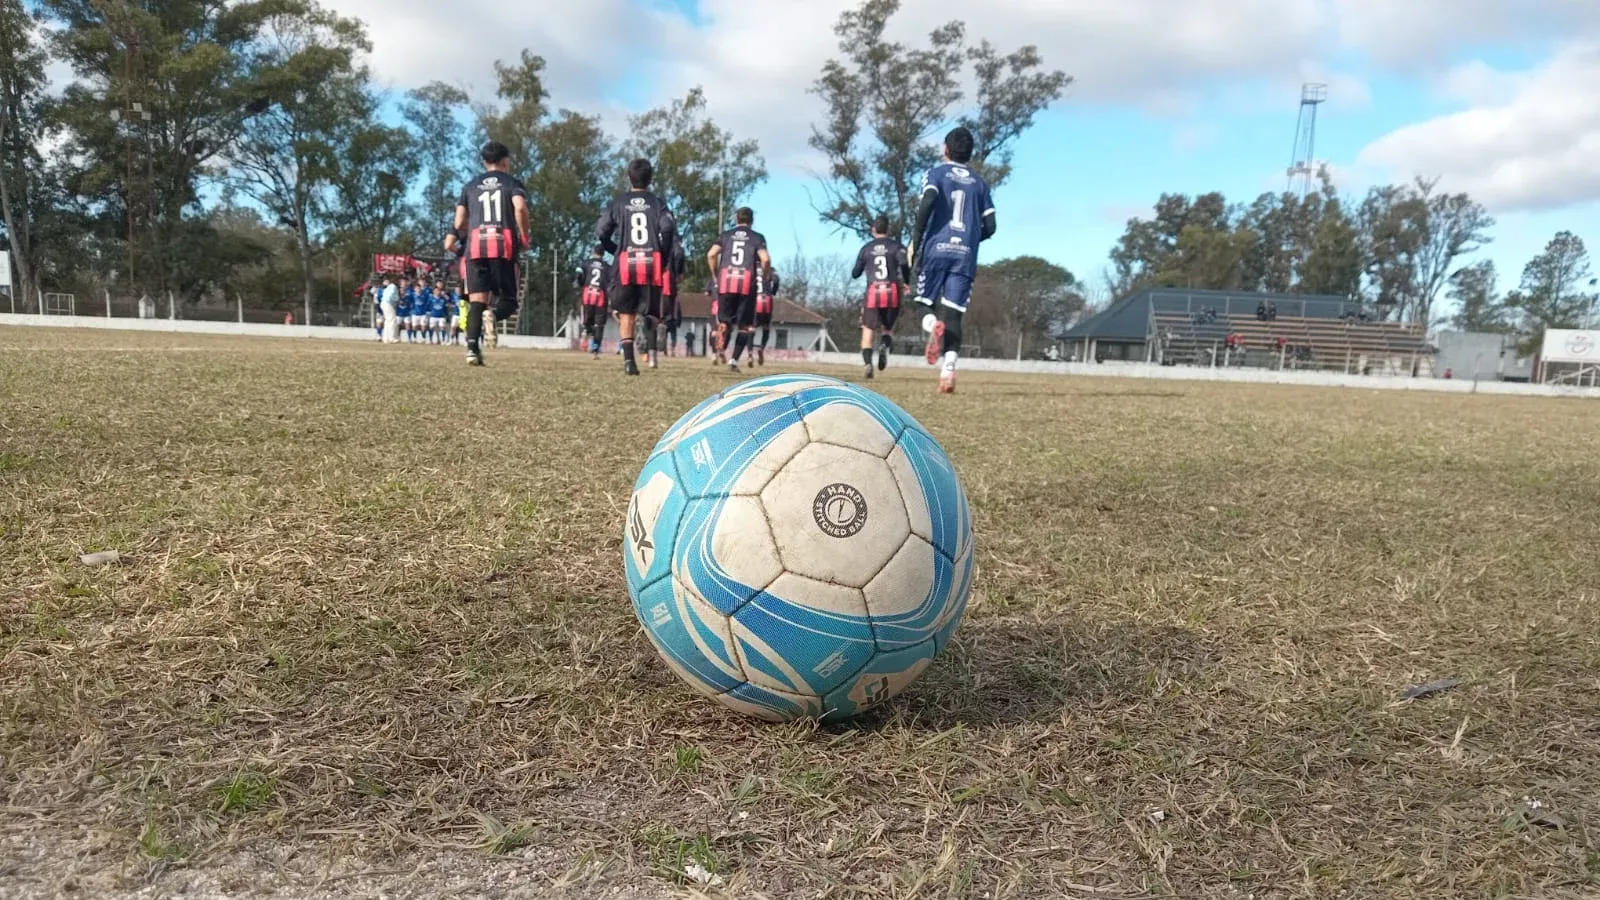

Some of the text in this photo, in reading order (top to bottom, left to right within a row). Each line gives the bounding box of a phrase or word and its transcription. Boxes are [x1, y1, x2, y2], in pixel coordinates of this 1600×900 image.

[478, 190, 501, 222] 11
[949, 190, 966, 231] 1
[631, 212, 648, 245] 8
[731, 241, 745, 265] 5
[590, 268, 601, 286] 2
[874, 256, 888, 279] 3
[827, 486, 861, 503] HAND
[816, 502, 865, 535] STITCHED BALL
